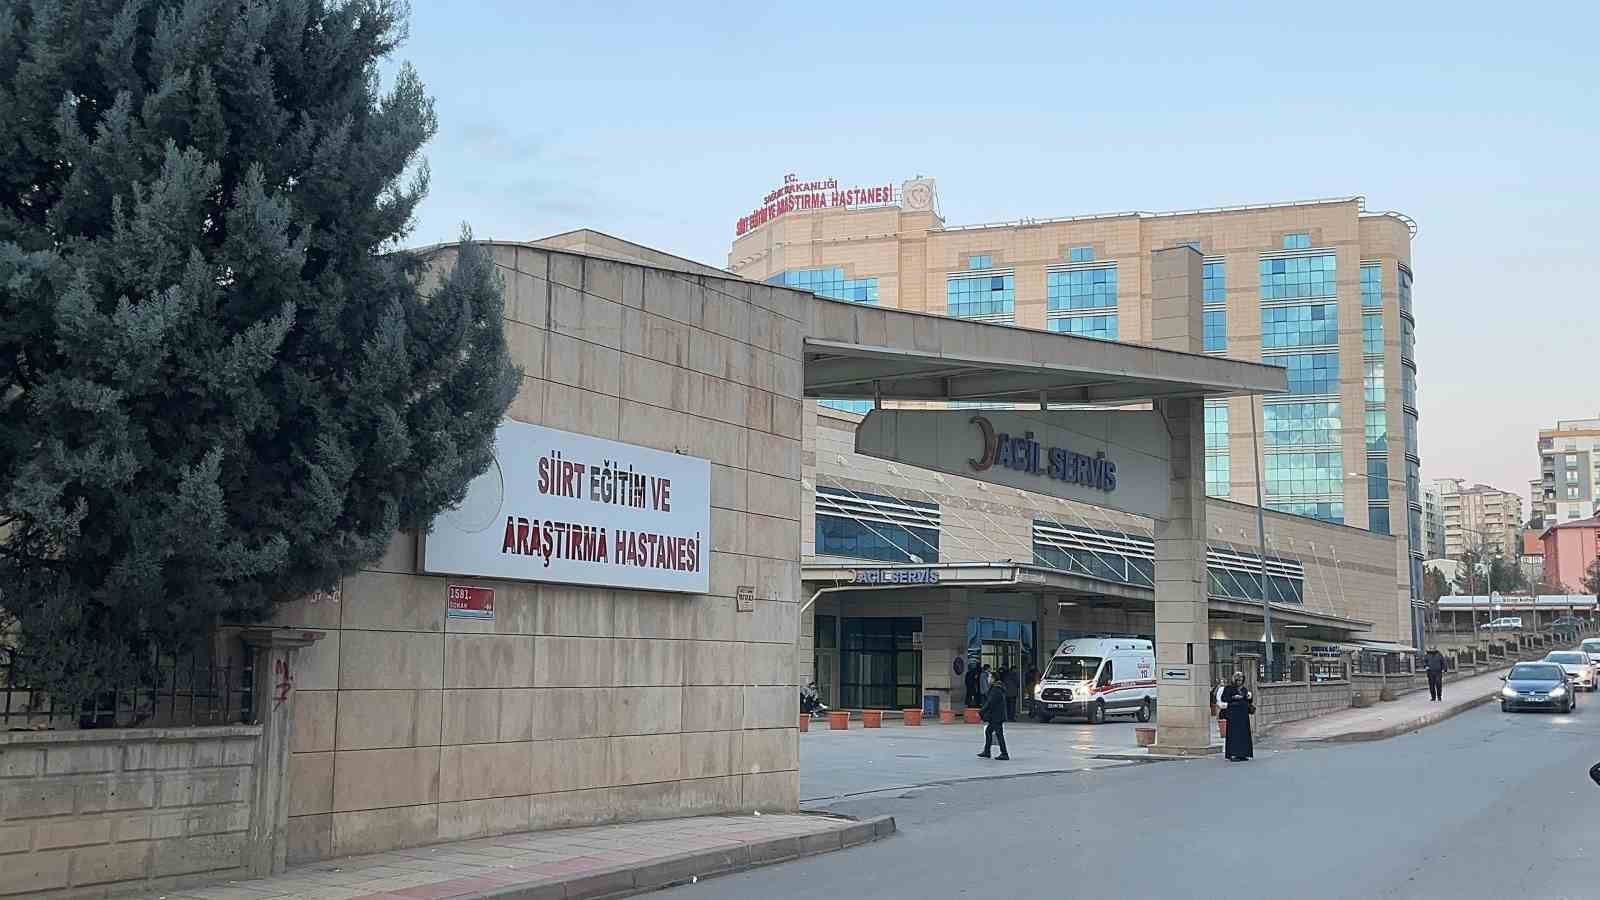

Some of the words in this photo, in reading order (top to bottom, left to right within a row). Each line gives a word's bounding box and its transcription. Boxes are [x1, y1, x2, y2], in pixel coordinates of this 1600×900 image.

[832, 184, 893, 207] HASTANESİ
[537, 450, 585, 499] SİİRT
[590, 460, 646, 509] EĞİTİM
[651, 475, 671, 512] VE
[994, 432, 1043, 475] ACİL
[1048, 448, 1117, 492] SERVİS
[502, 515, 609, 568] ARAŞTIRMA
[615, 529, 700, 572] HASTANESİ
